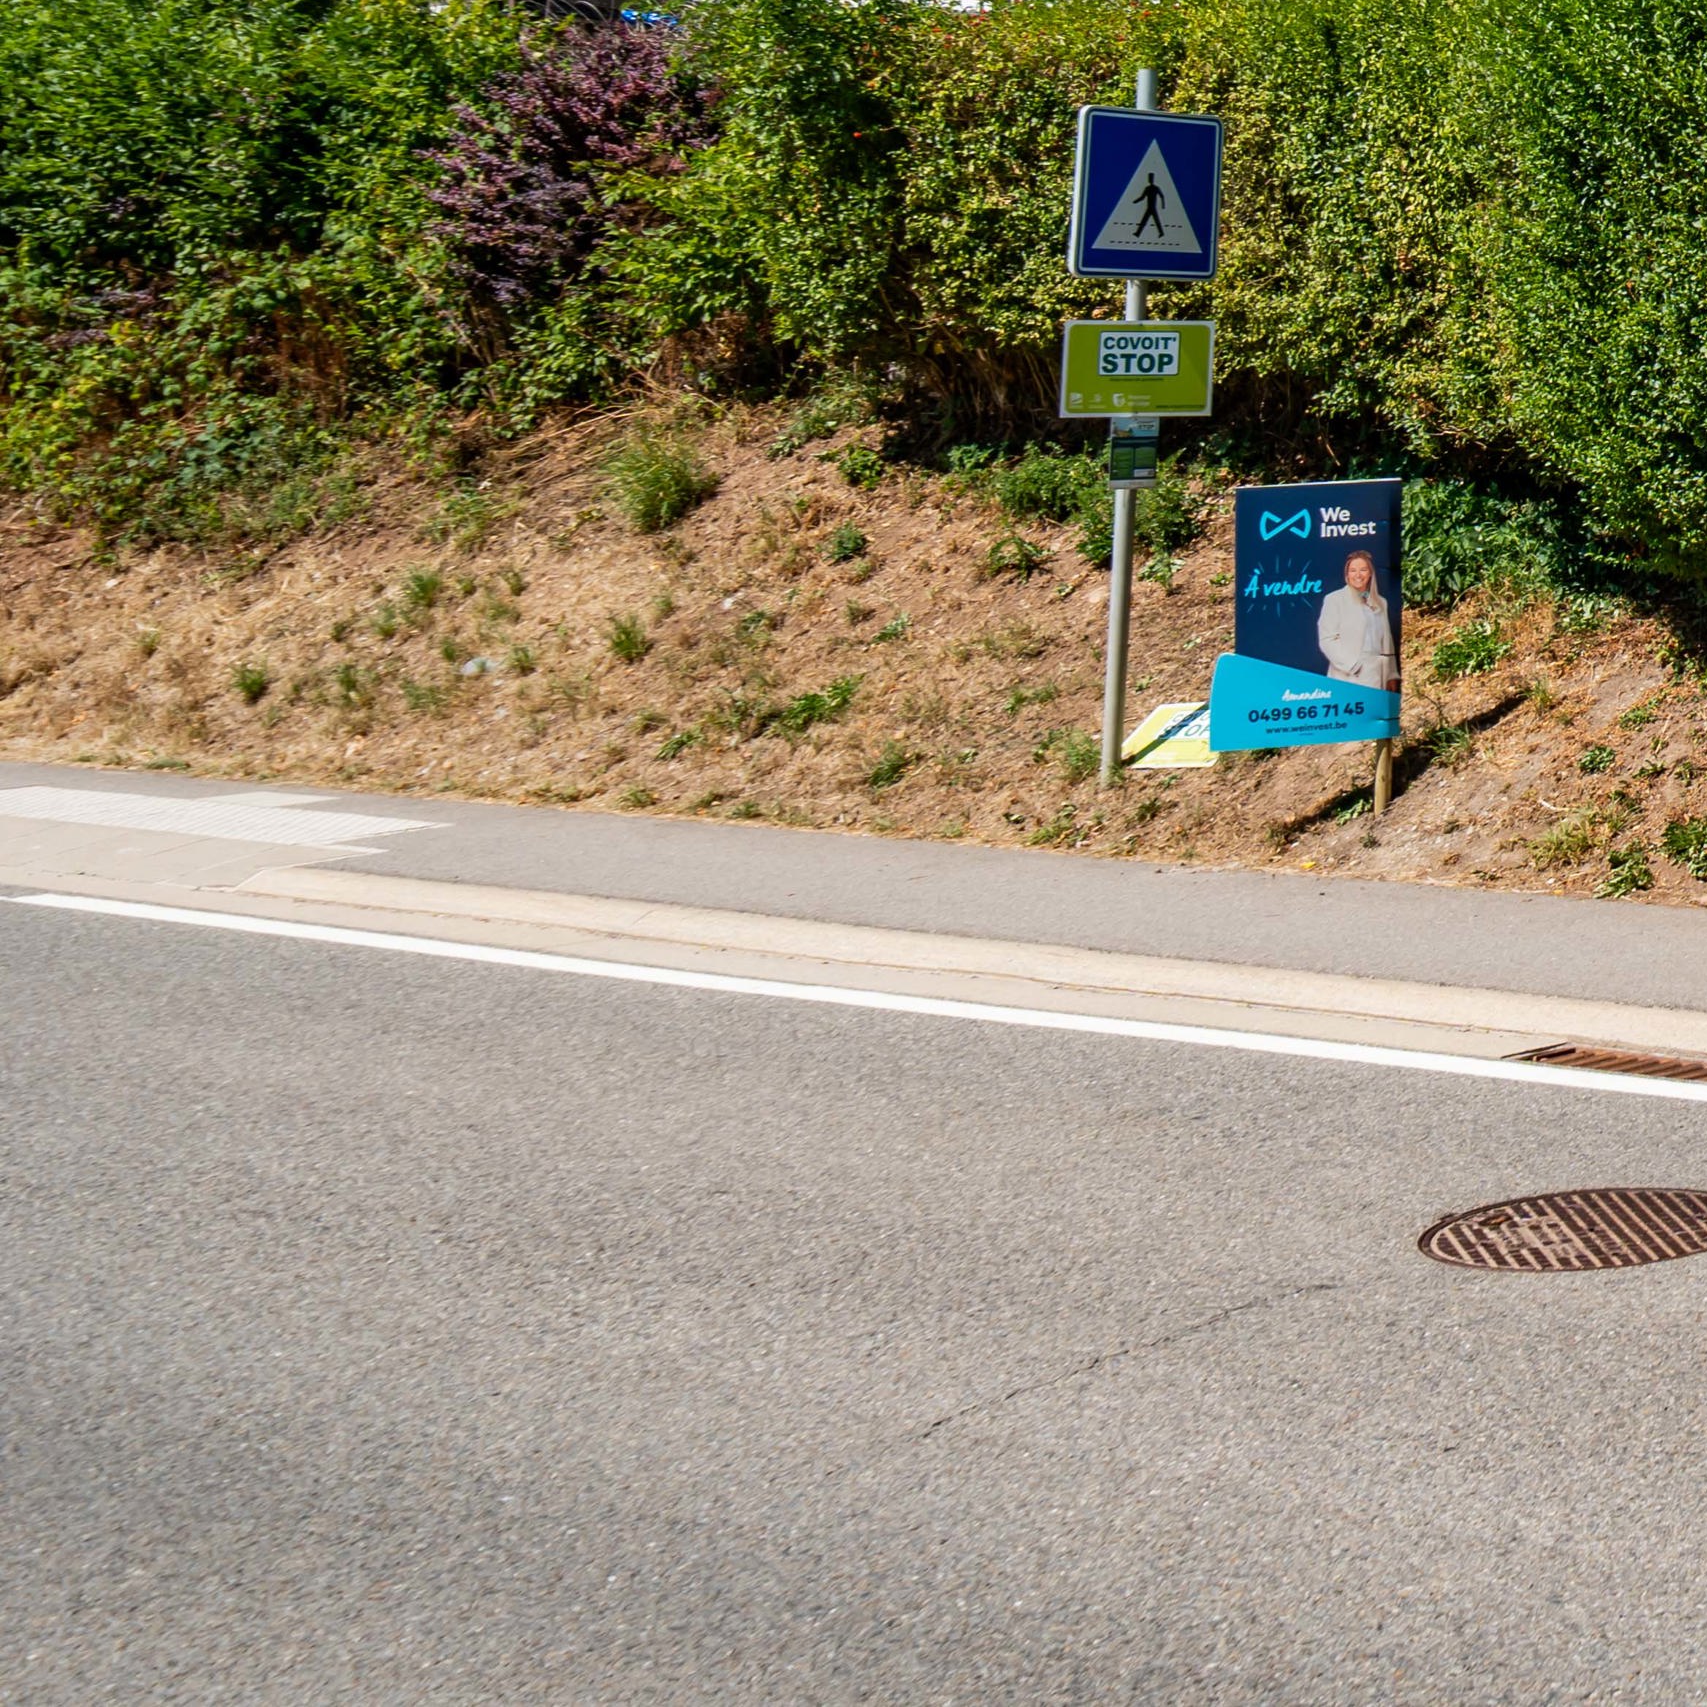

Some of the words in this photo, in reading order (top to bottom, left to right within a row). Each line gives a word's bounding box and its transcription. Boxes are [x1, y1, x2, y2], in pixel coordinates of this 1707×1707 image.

[1103, 336, 1176, 350] COVOIT'
[1101, 353, 1174, 374] STOP
[1319, 506, 1351, 523] We
[1320, 521, 1377, 538] Invest
[1244, 568, 1261, 599] À
[1263, 574, 1323, 597] vendre
[1248, 707, 1292, 723] 0499
[1296, 705, 1318, 720] 66
[1322, 704, 1339, 718] 71
[1343, 701, 1365, 715] 45
[1265, 721, 1348, 734] www.weinvest.be
